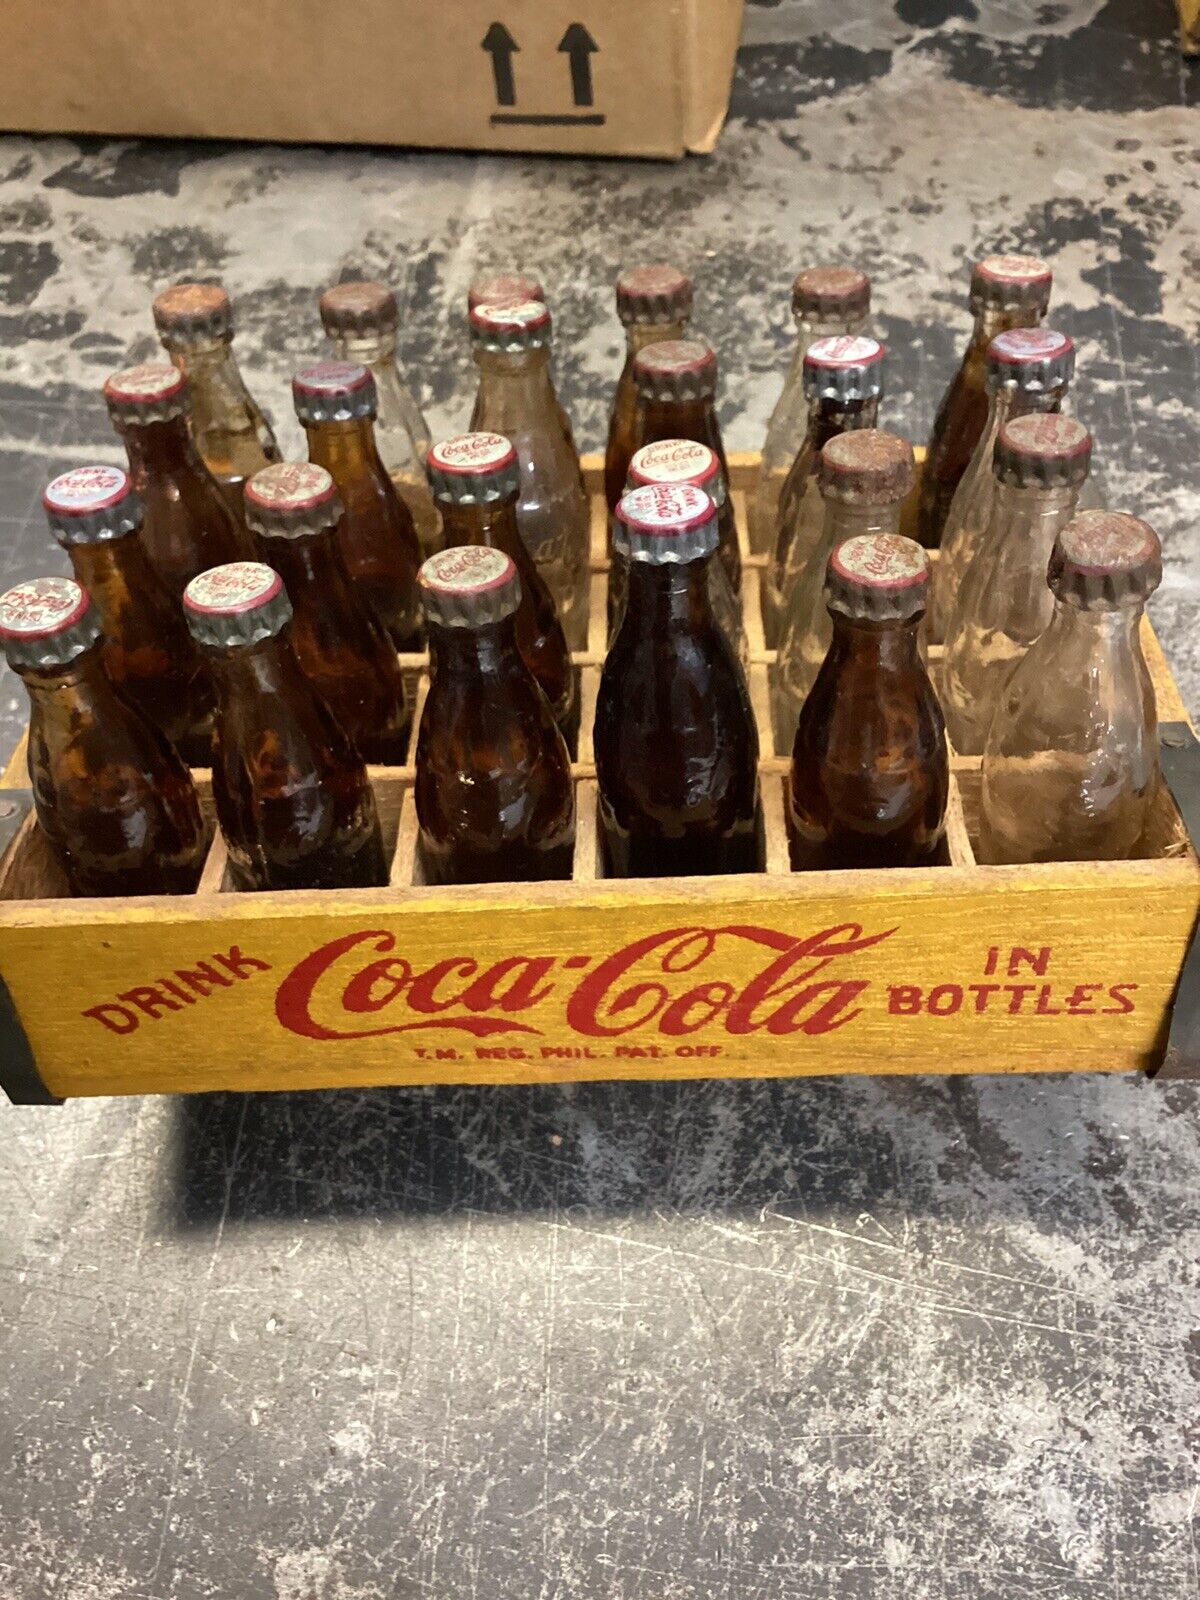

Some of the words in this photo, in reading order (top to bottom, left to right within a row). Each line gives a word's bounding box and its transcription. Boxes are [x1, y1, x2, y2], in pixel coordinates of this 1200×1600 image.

[984, 946, 1051, 976] IN
[80, 945, 273, 1035] DRINK
[275, 923, 899, 1040] Coca-Cola
[886, 983, 1139, 1016] BOTTLES
[474, 1046, 534, 1060] REG.
[540, 1046, 606, 1059] PHIL.
[615, 1045, 668, 1059] PAT.
